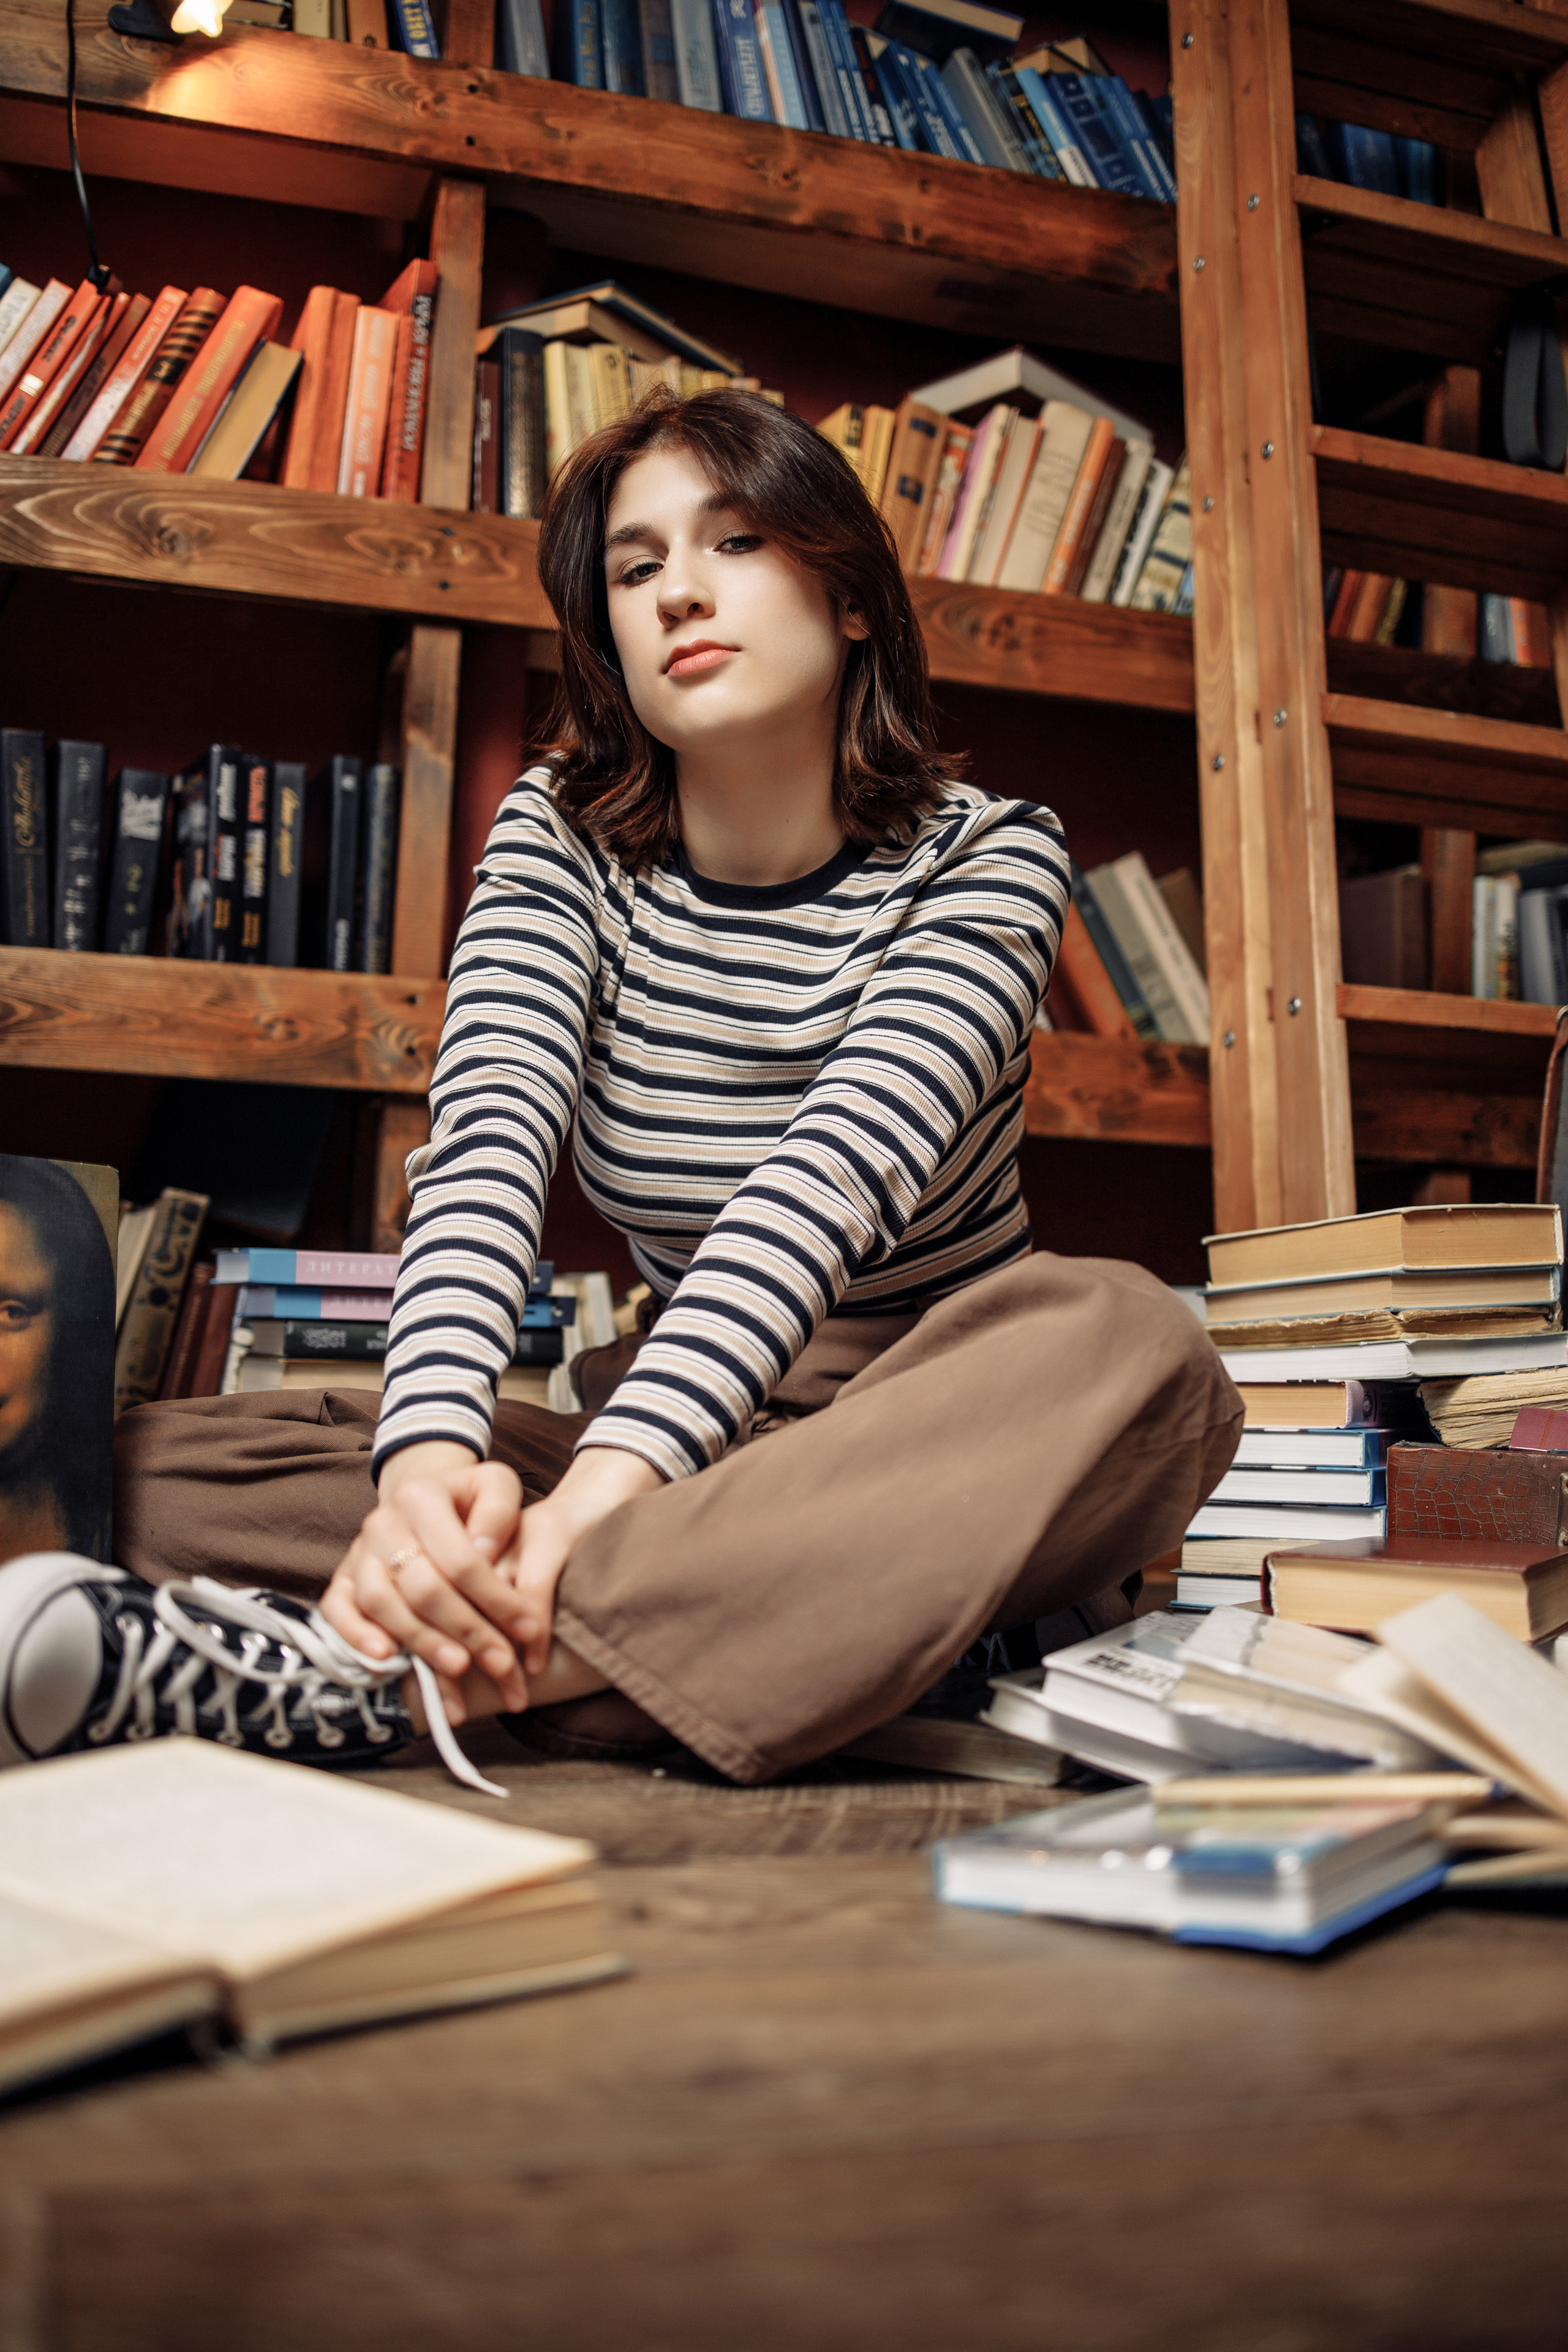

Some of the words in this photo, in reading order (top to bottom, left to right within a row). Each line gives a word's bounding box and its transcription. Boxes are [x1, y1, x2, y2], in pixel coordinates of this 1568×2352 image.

[412, 294, 432, 344] КРЫМ
[401, 357, 426, 451] РОМАНОВЫ
[306, 1260, 396, 1276] ЛИТЕРАТ
